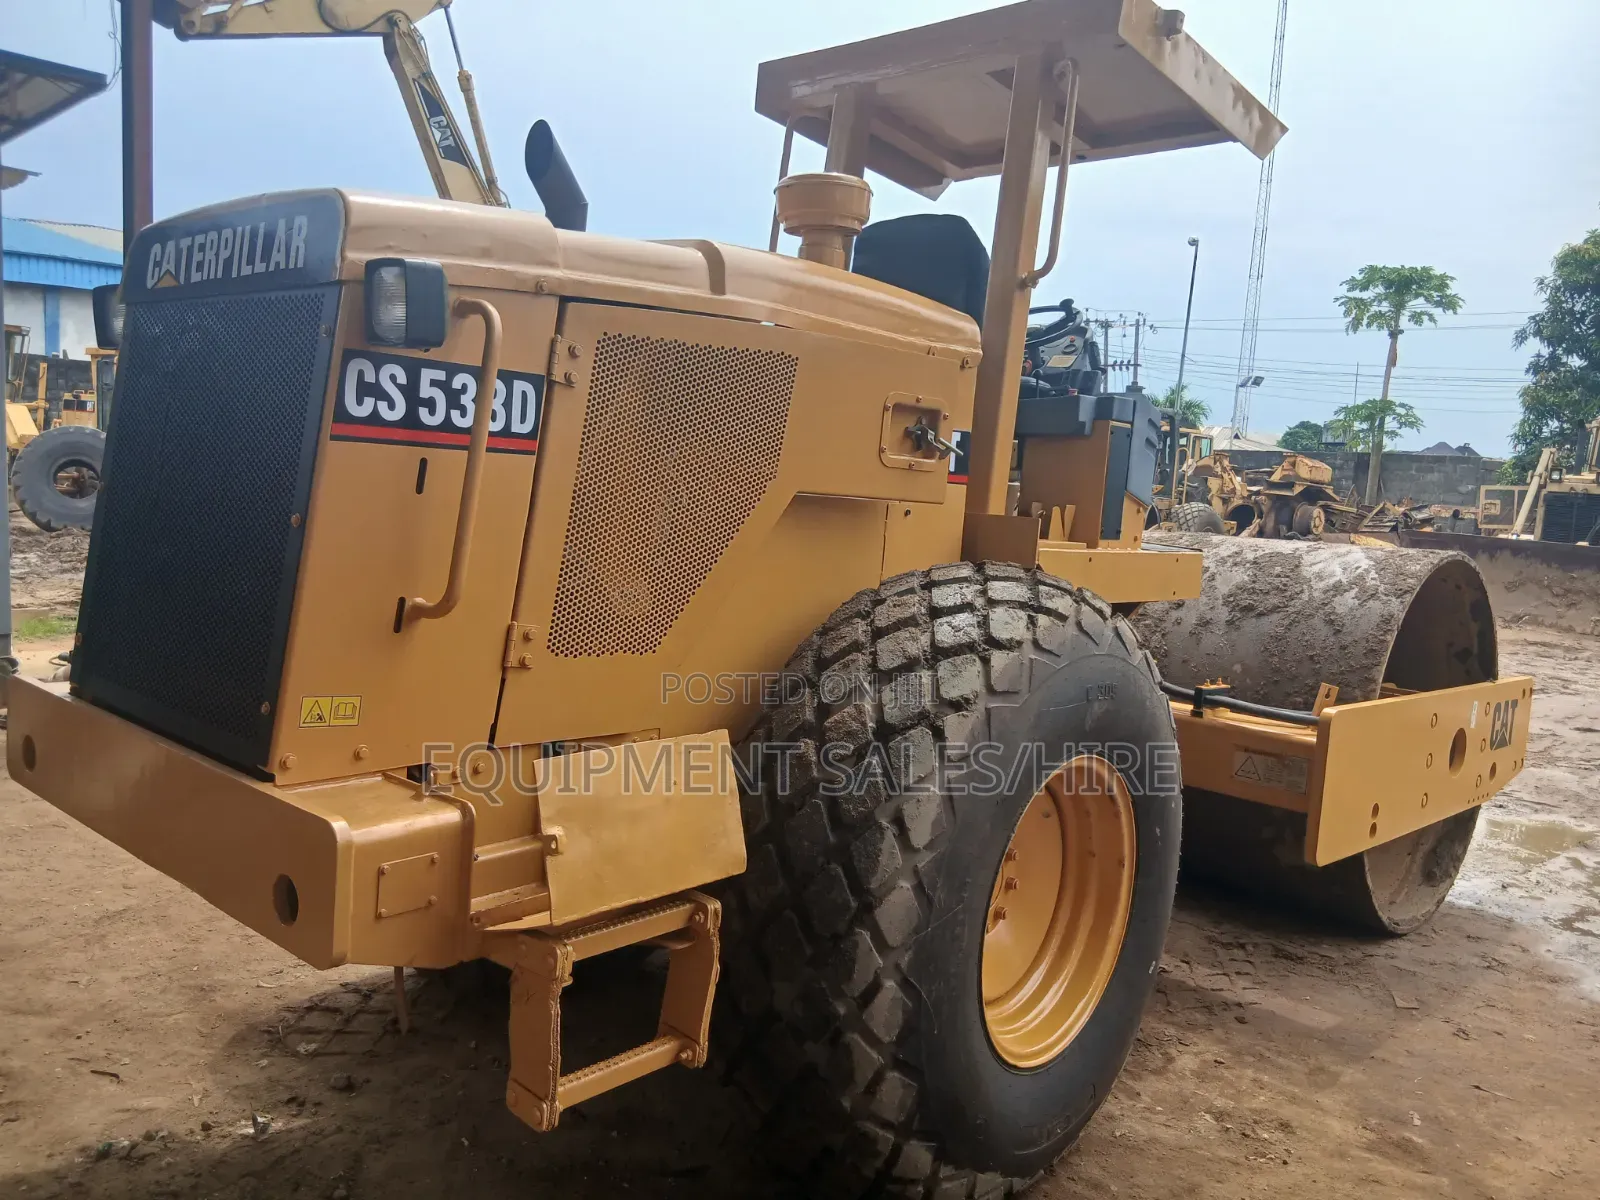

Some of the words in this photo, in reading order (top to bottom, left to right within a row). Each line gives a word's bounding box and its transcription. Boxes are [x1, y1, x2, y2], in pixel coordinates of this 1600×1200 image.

[429, 115, 455, 147] CAT
[146, 215, 308, 289] CATERPILLAR
[344, 358, 408, 422] CS
[1489, 698, 1518, 751] CAT
